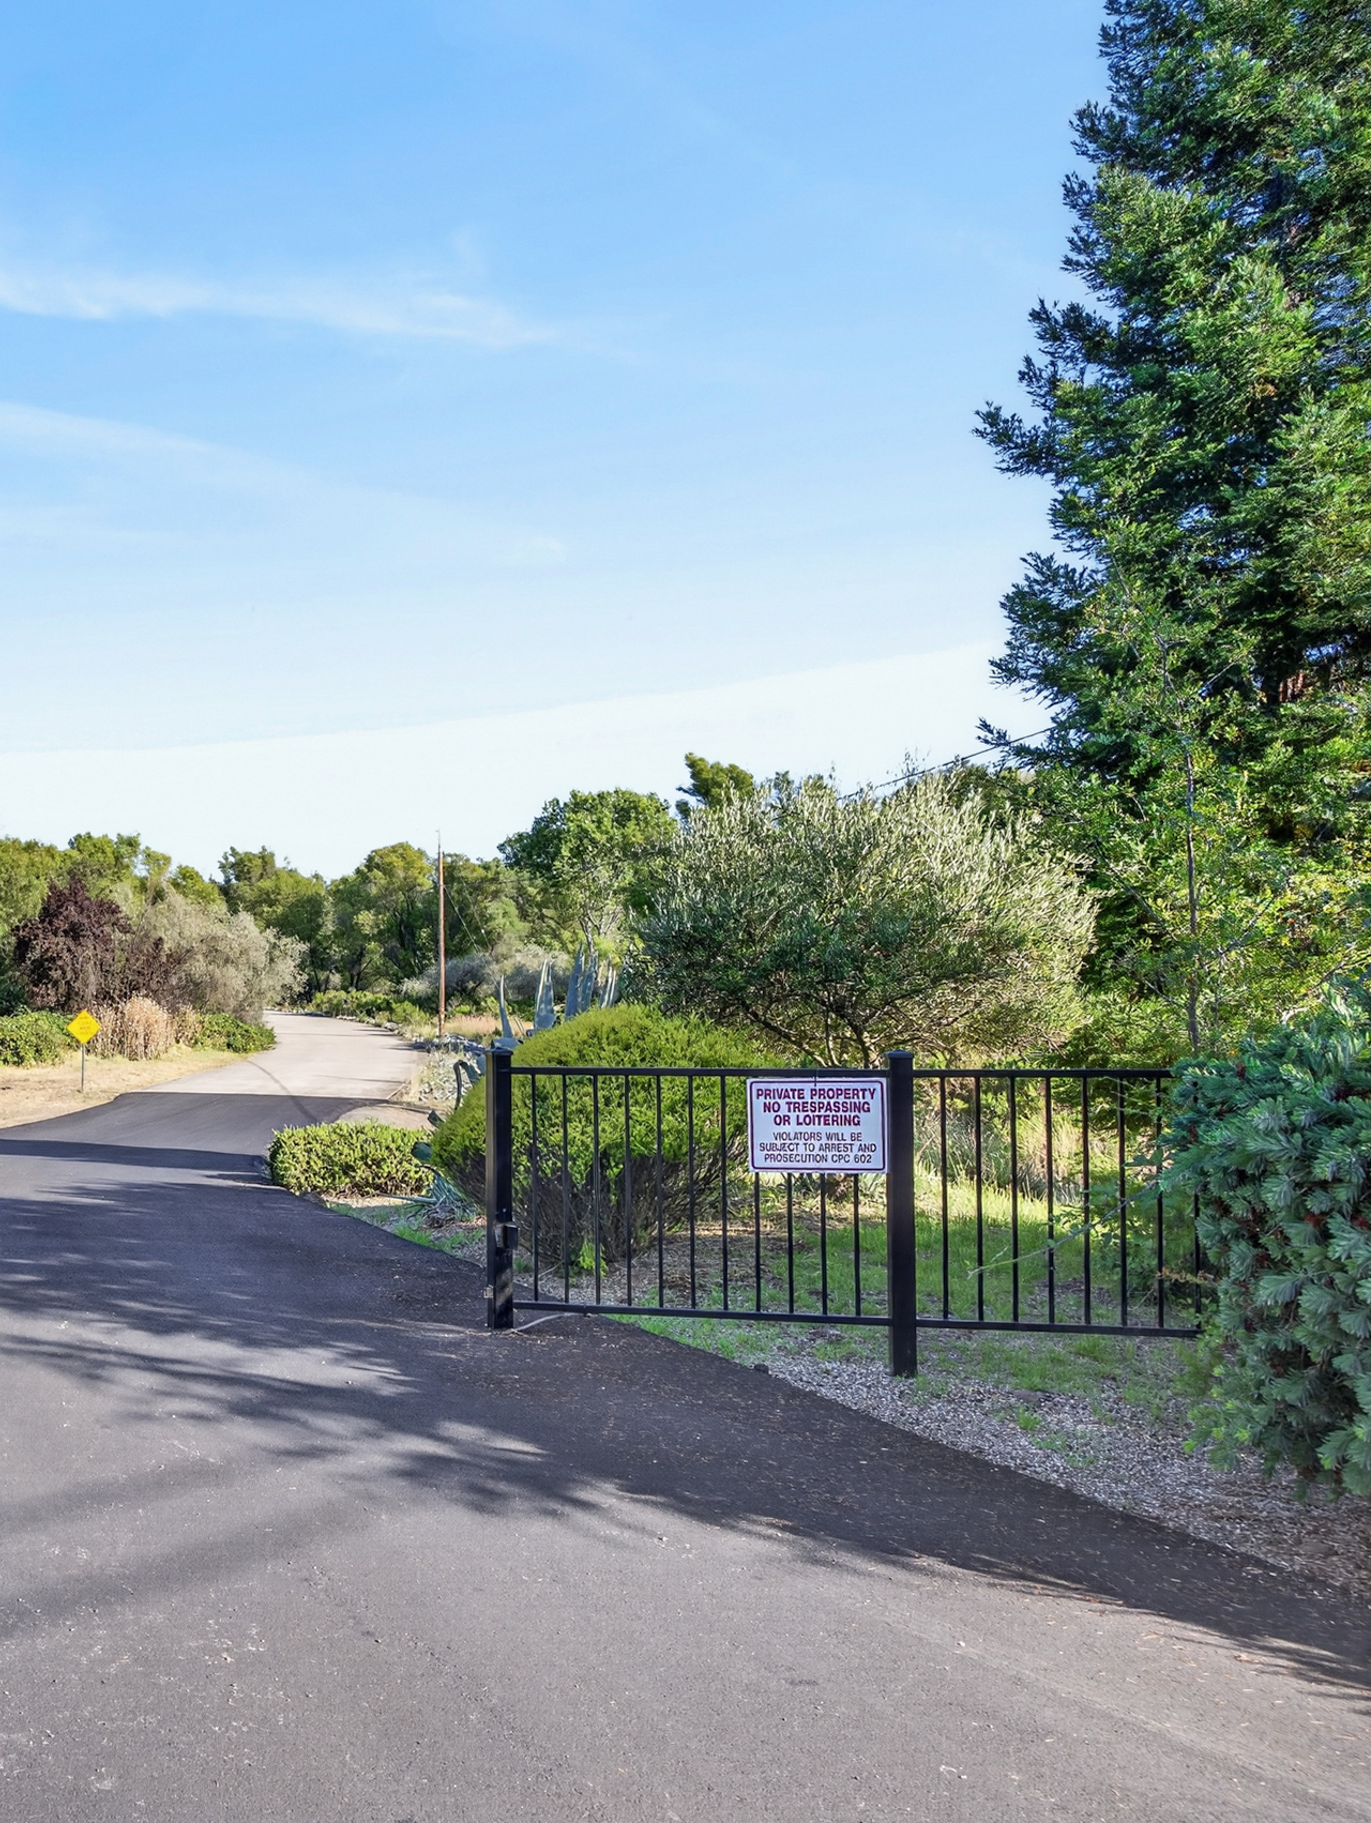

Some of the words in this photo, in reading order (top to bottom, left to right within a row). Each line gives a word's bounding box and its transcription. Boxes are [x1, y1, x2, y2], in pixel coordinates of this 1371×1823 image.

[756, 1088, 805, 1099] PRIVATE
[811, 1088, 876, 1099] PROPERTY
[763, 1101, 780, 1113] NO
[786, 1101, 870, 1113] TRESPASSING
[774, 1114, 790, 1126] OR
[796, 1114, 861, 1126] LOITERING
[773, 1132, 822, 1141] VIOLATORS
[826, 1132, 846, 1141] WILL
[851, 1132, 862, 1141] BE
[759, 1143, 799, 1152] SUBJECT
[803, 1143, 815, 1152] TO
[819, 1143, 854, 1152] ARREST
[858, 1143, 877, 1152] AND
[765, 1154, 827, 1163] PROSECUTION
[831, 1154, 850, 1163] CPC
[854, 1154, 871, 1163] 602
